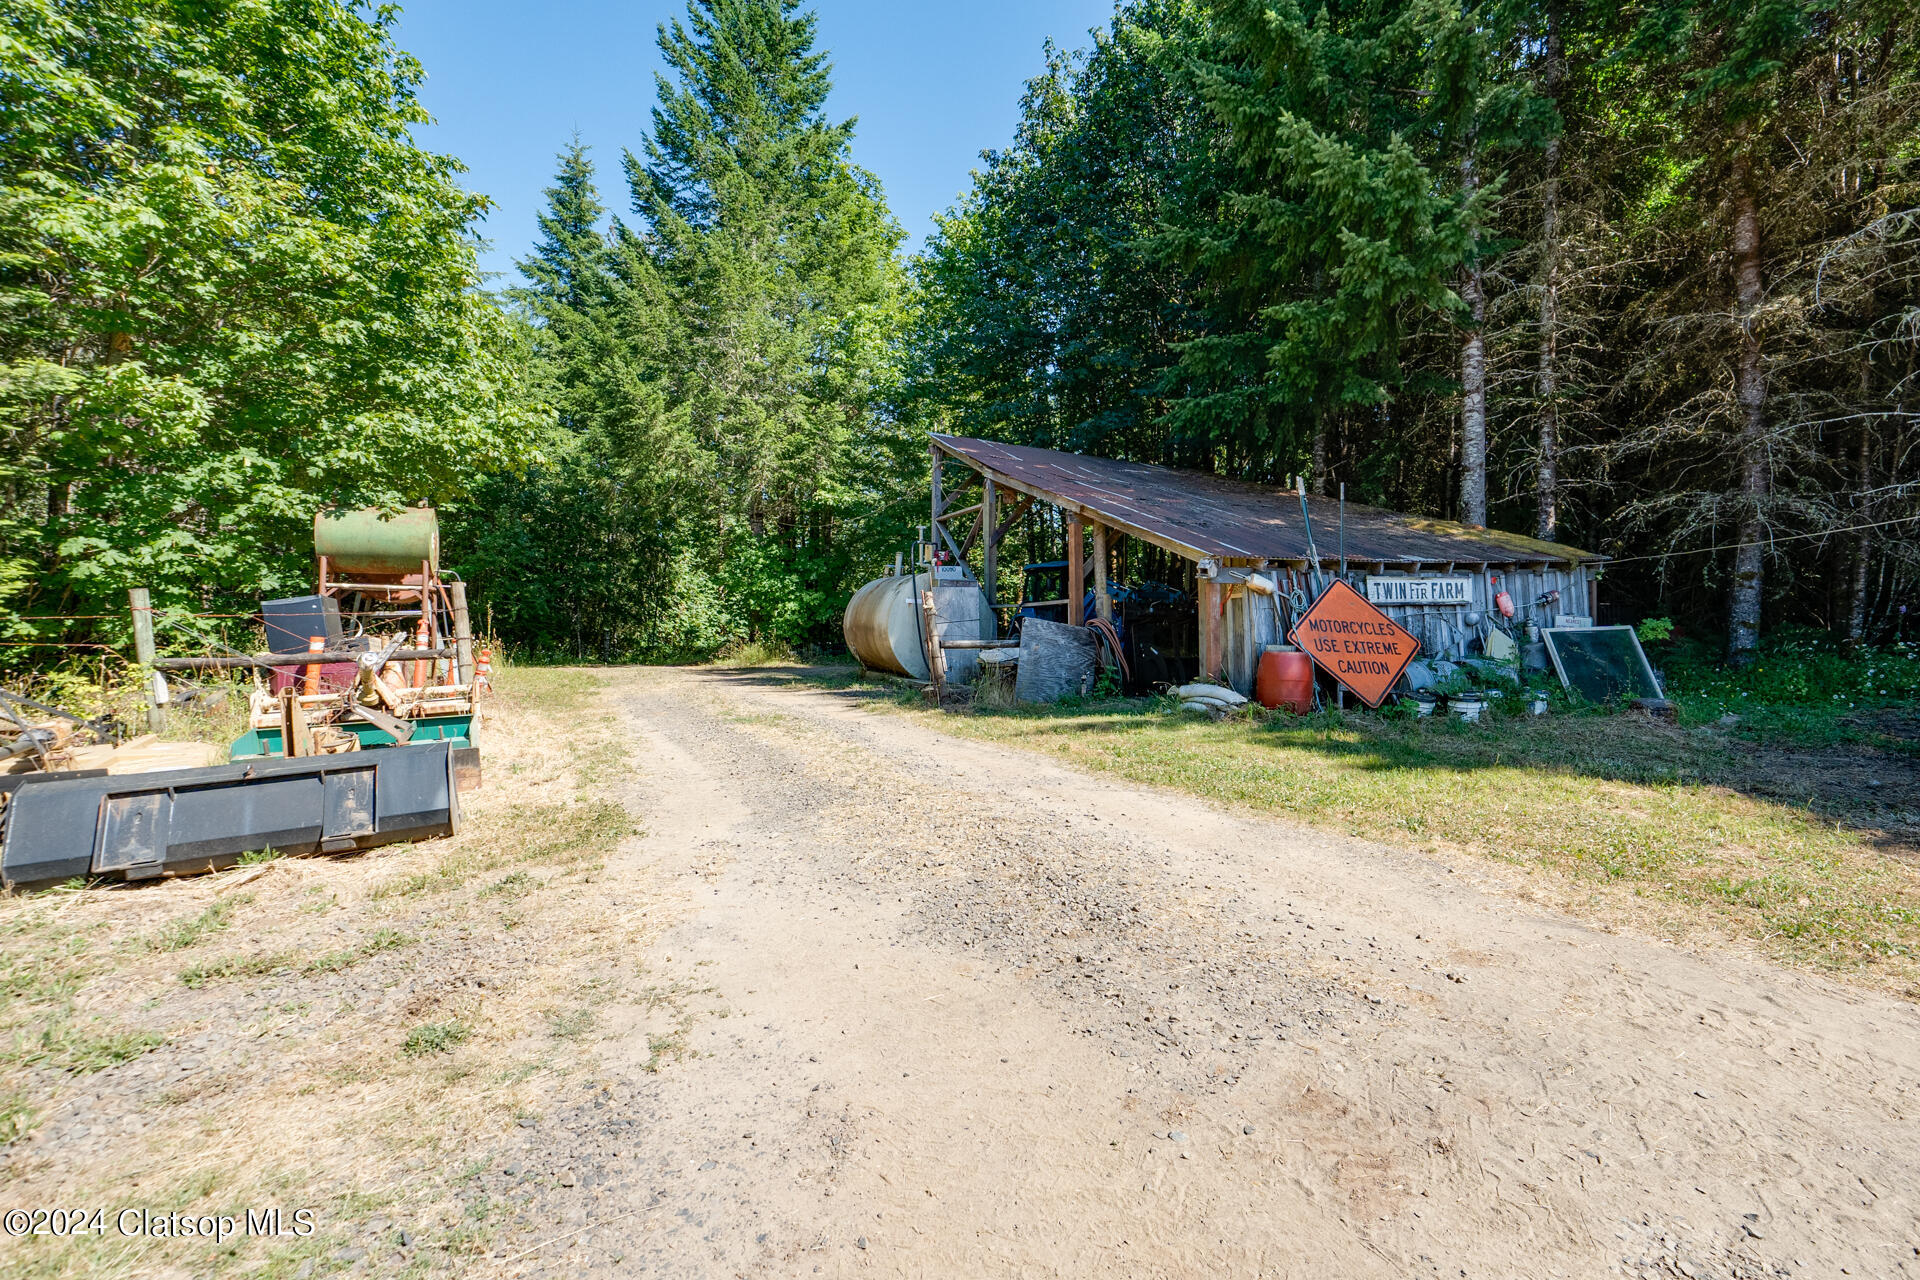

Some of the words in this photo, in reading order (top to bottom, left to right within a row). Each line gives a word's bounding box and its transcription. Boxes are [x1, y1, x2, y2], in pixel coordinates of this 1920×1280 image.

[1373, 582, 1407, 600] TWIN
[1409, 582, 1428, 600] FIR
[1431, 582, 1465, 600] FARM
[1308, 618, 1395, 636] MOTORCYCLES
[1313, 638, 1341, 653] USE
[1343, 640, 1402, 656] EXTREME
[1337, 659, 1391, 675] CAUTION
